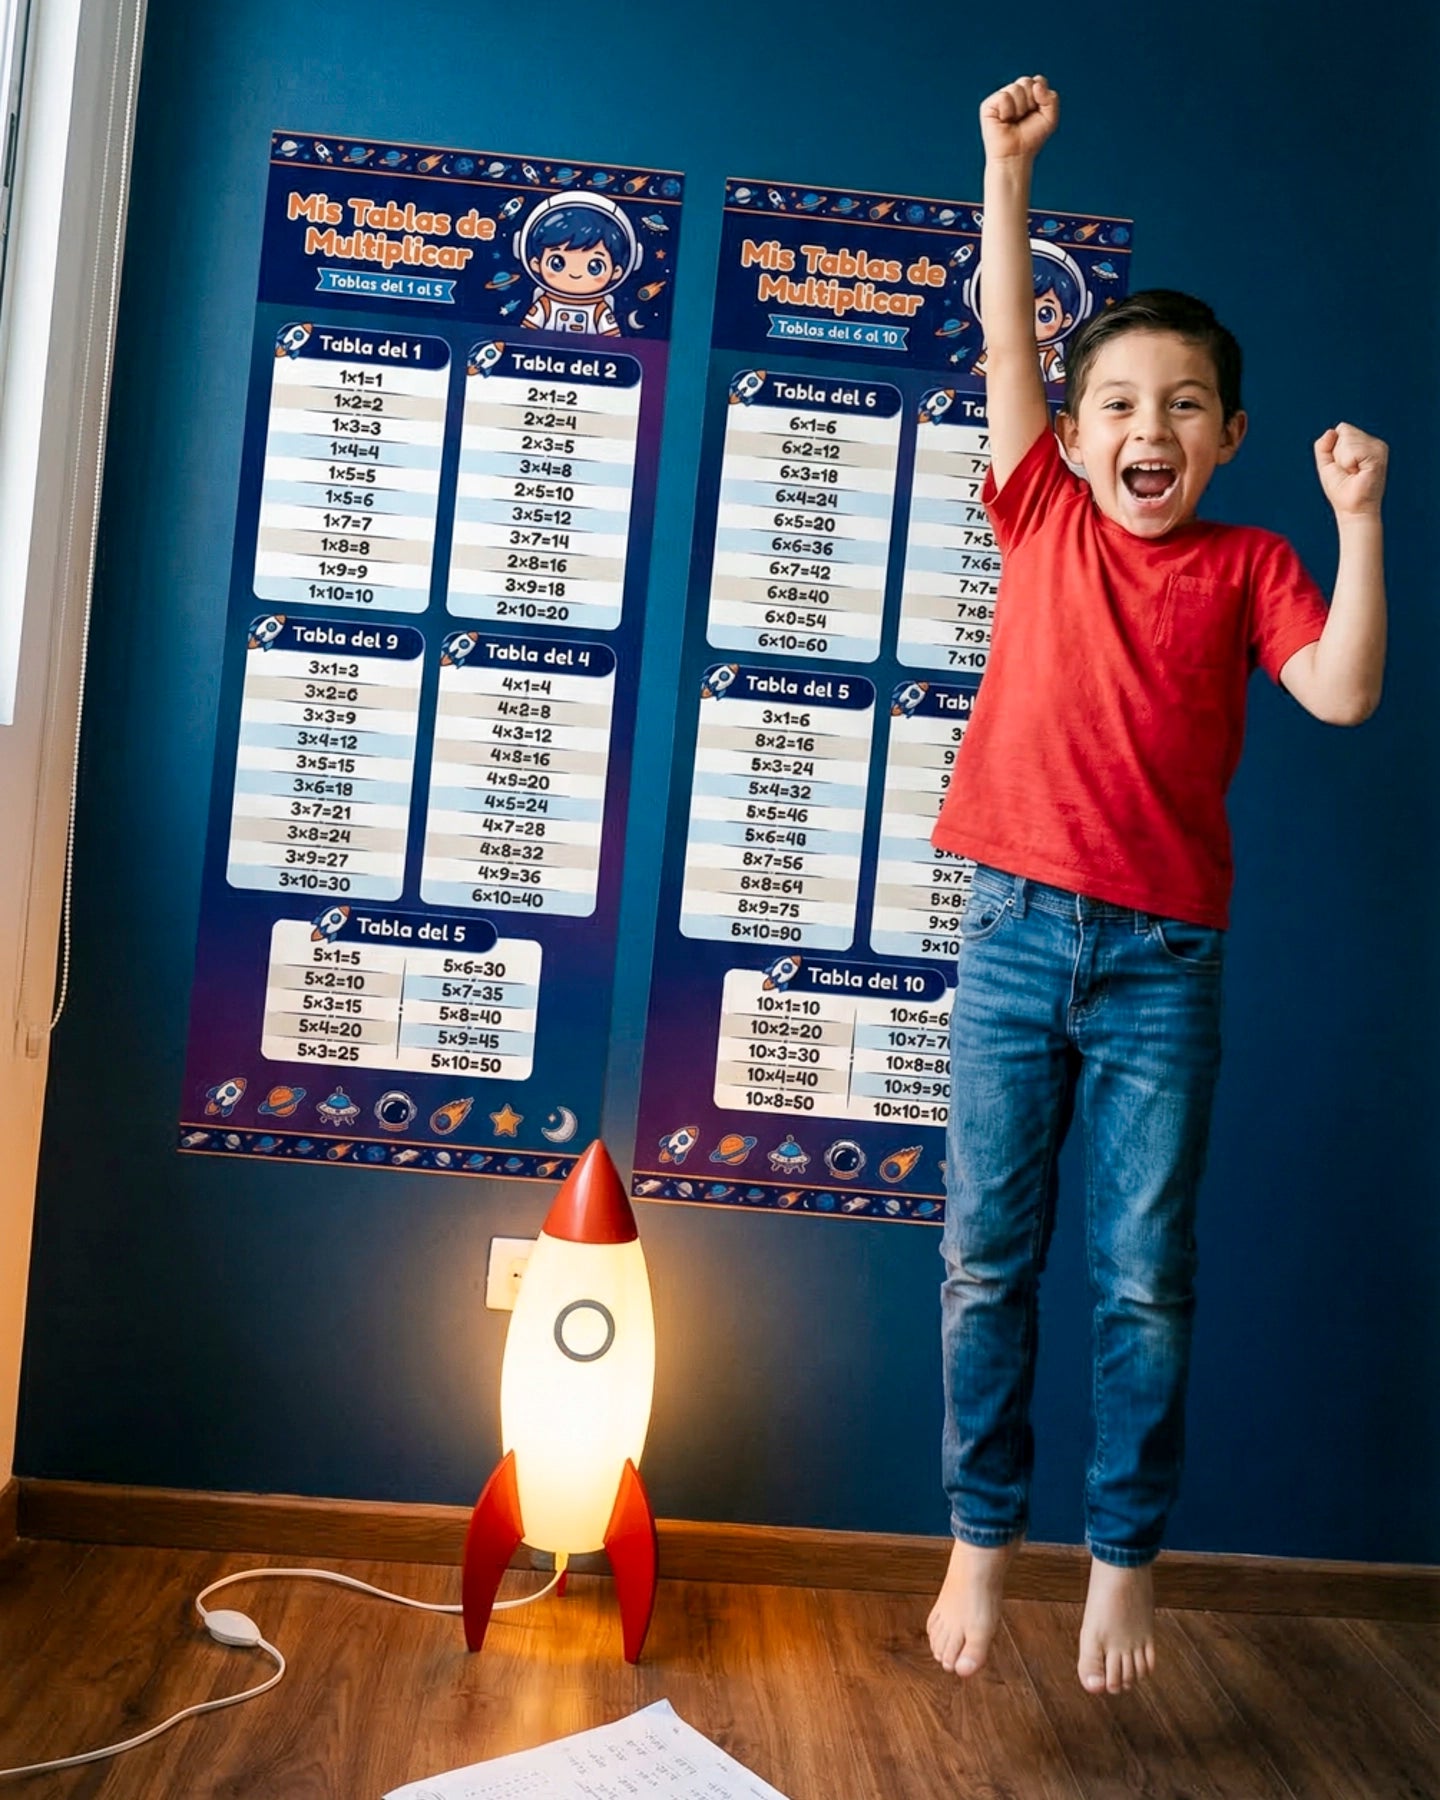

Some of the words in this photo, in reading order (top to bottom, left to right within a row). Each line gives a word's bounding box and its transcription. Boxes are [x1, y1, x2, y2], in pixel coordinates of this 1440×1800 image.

[287, 192, 342, 225] Mis
[348, 198, 451, 235] Tablas
[456, 208, 496, 241] de
[305, 226, 473, 270] Multiplicar
[741, 239, 795, 271] Mis
[801, 245, 902, 282] Tablas
[907, 256, 946, 287] de
[329, 274, 376, 290] Tablas
[381, 280, 403, 293] del
[408, 283, 414, 293] 1
[417, 284, 431, 296] al
[758, 273, 925, 316] Multiplicar
[828, 326, 848, 339] del
[854, 329, 862, 340] 6
[882, 331, 897, 344] 10
[320, 335, 372, 355] Tabla
[378, 341, 408, 358] del
[413, 344, 421, 360] 1
[512, 354, 565, 373] Tabla
[570, 360, 599, 376] del
[604, 363, 617, 378] 2
[773, 382, 826, 402] Tabla
[831, 387, 860, 405] del
[865, 392, 876, 407] 6
[964, 532, 999, 546] 7×5
[962, 556, 1001, 571] 7×6=
[960, 580, 998, 594] 7×7=
[958, 604, 995, 618] 7×8=
[293, 626, 346, 645] Tabla
[351, 631, 380, 648] del
[387, 635, 398, 649] 9
[955, 628, 991, 642] 7×9=
[486, 643, 538, 662] Tabla
[544, 649, 573, 665] del
[578, 652, 590, 667] 4
[948, 651, 986, 666] 7×10
[747, 676, 798, 694] Tabla
[804, 681, 832, 697] del
[838, 685, 850, 699] 5
[936, 693, 974, 710] Tabl
[932, 869, 972, 883] 9×7=
[357, 917, 412, 937] Tabla
[418, 923, 448, 941] del
[454, 926, 466, 942] 5
[929, 916, 959, 930] 9×9
[922, 939, 960, 955] 9×10
[808, 967, 862, 987] Tabla
[868, 972, 898, 990] del
[904, 976, 925, 992] 10
[890, 1008, 949, 1026] 10×6=6
[889, 1032, 951, 1049] 10×7=7
[874, 1102, 948, 1121] 10×10=10
